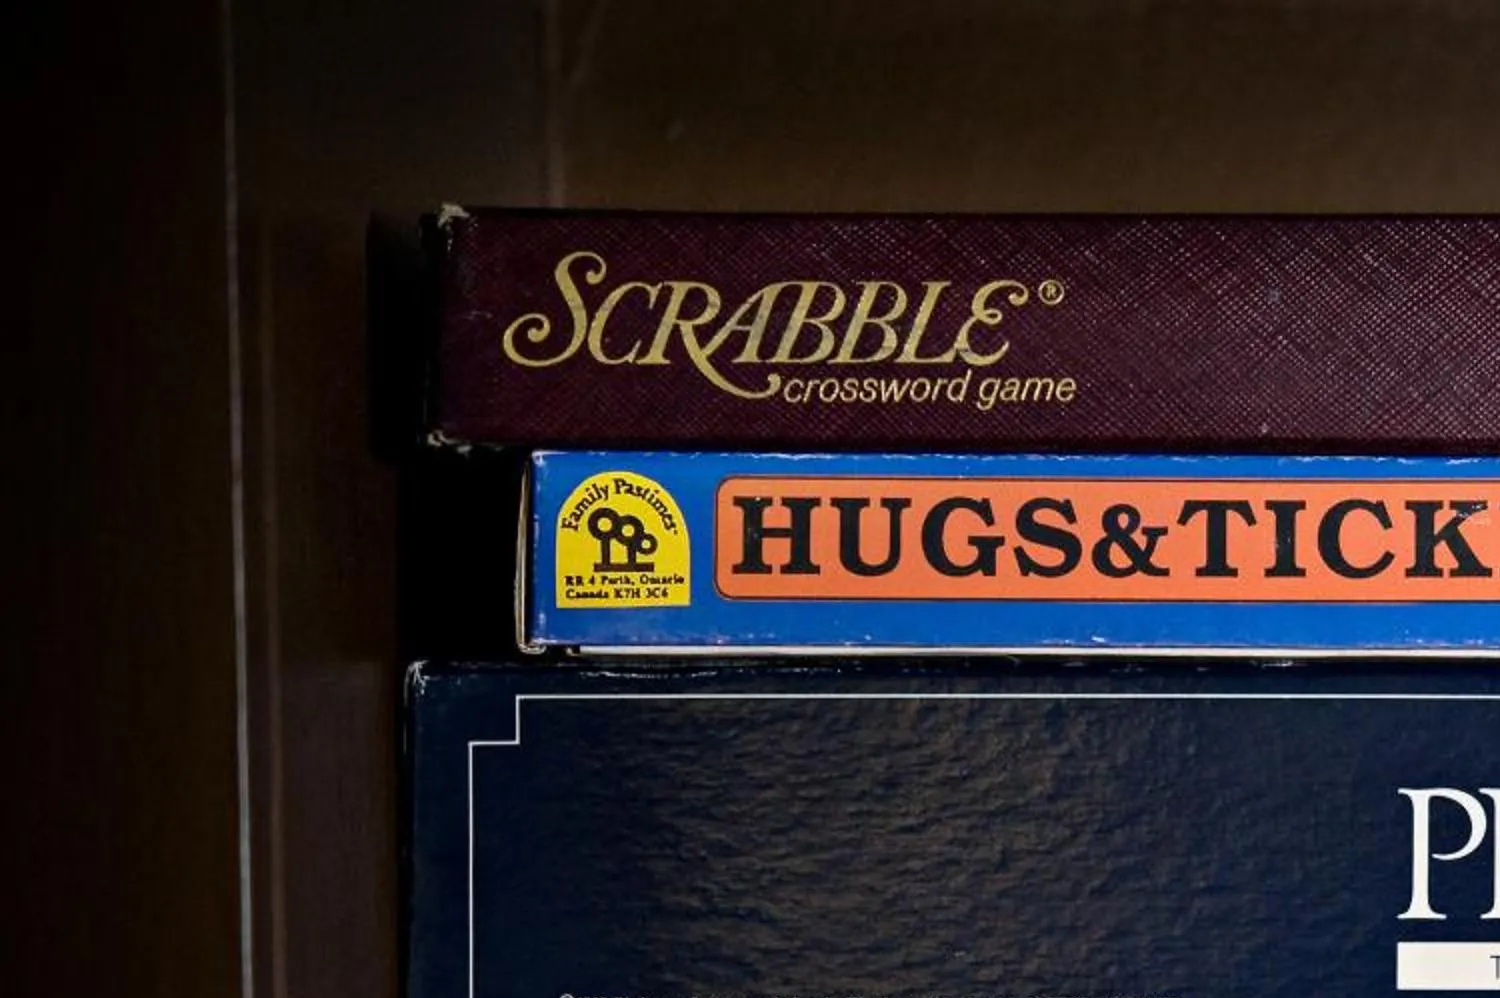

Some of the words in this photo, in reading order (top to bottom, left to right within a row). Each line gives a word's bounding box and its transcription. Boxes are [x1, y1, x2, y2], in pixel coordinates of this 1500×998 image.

[782, 371, 972, 403] crossword
[978, 376, 1077, 411] game
[561, 483, 609, 531] Family
[564, 575, 584, 585] RR
[588, 576, 595, 585] 4
[565, 588, 609, 599] Canada
